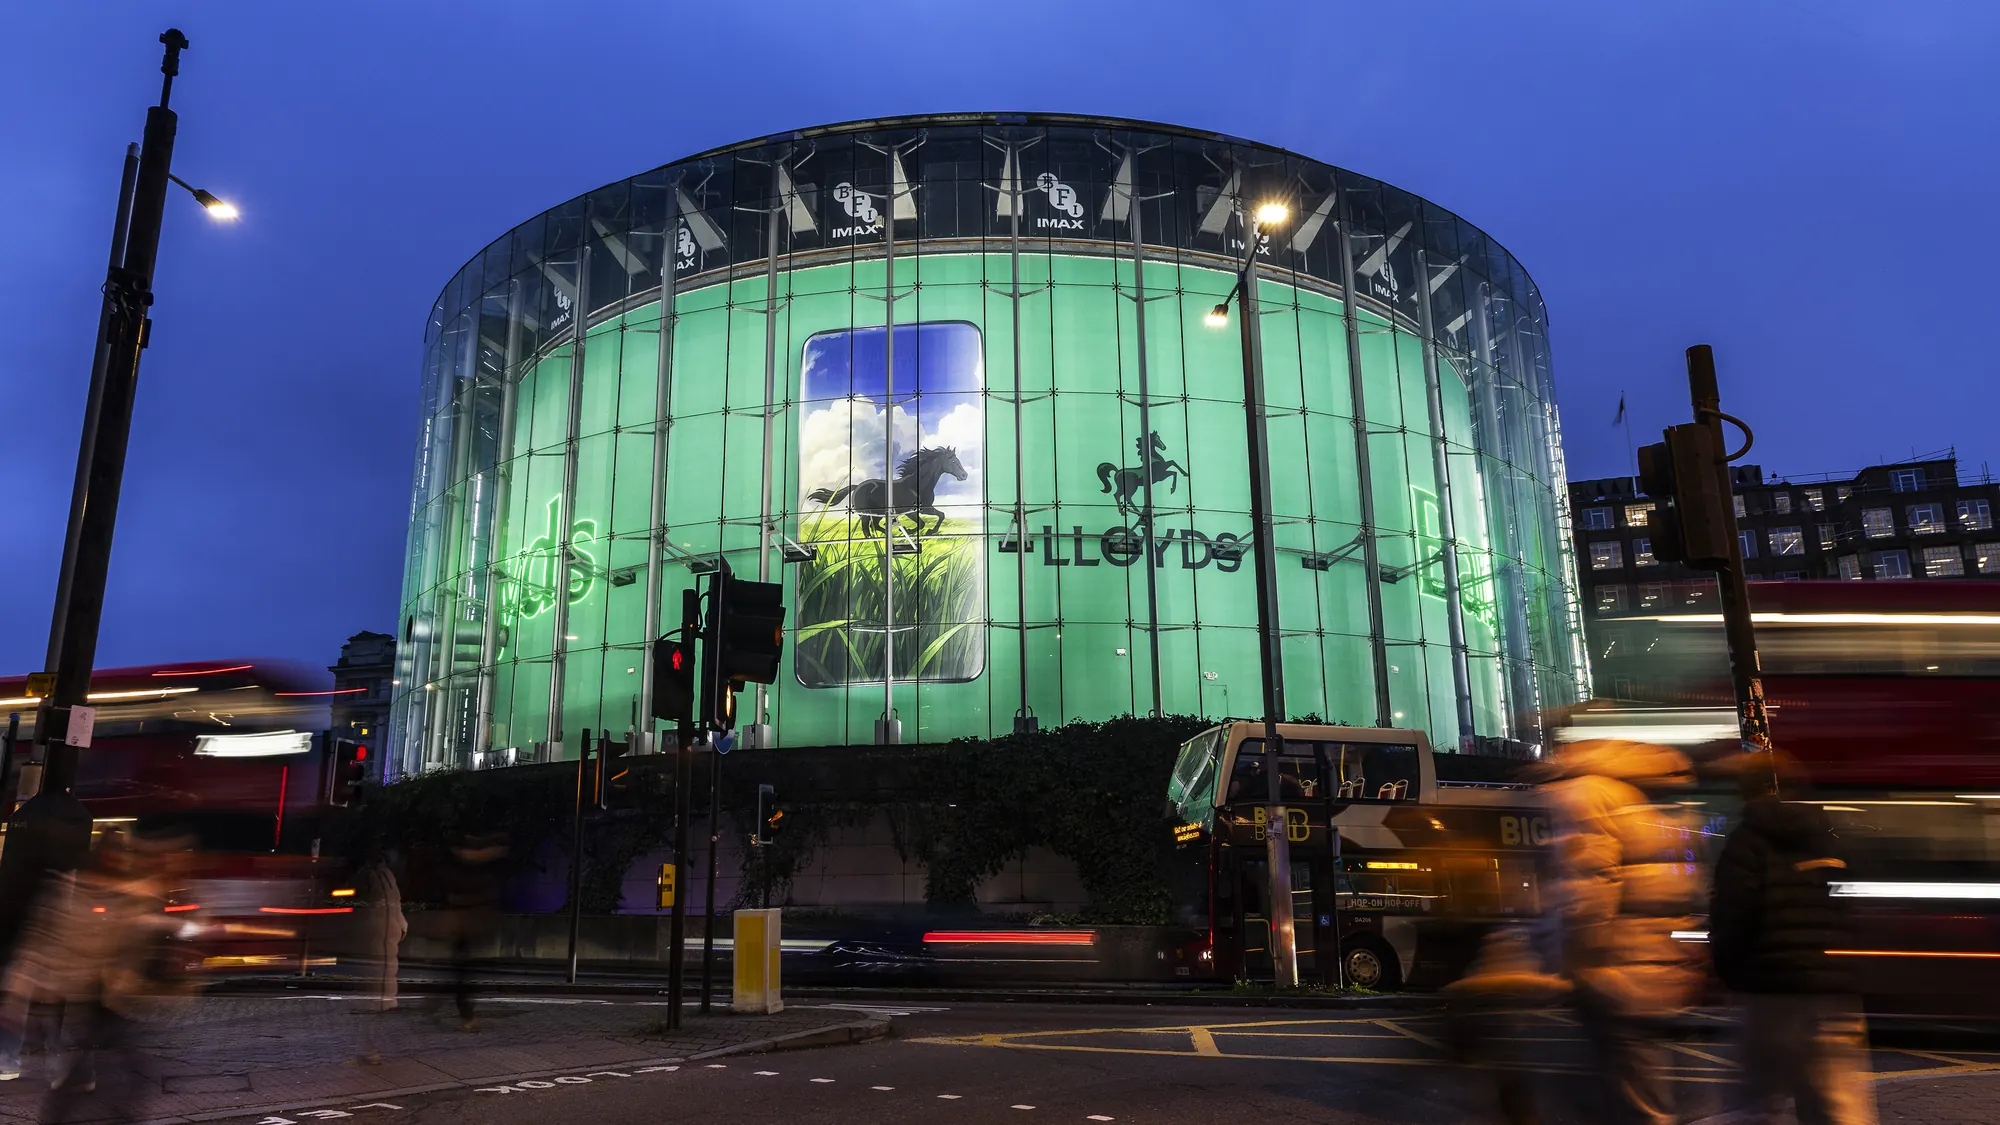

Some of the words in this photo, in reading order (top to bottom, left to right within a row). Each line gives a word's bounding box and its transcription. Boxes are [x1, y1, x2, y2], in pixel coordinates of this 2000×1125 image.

[837, 184, 874, 222] BFI
[1041, 174, 1080, 217] BFI
[832, 224, 878, 239] IMAX
[1037, 218, 1085, 230] IMAX
[1231, 239, 1270, 256] IMX
[1375, 283, 1400, 304] IMAX
[1042, 525, 1243, 573] LLOYDS
[1500, 815, 1551, 847] BIG
[1351, 898, 1383, 908] HOP-ON
[1384, 899, 1421, 909] HOP-OFF
